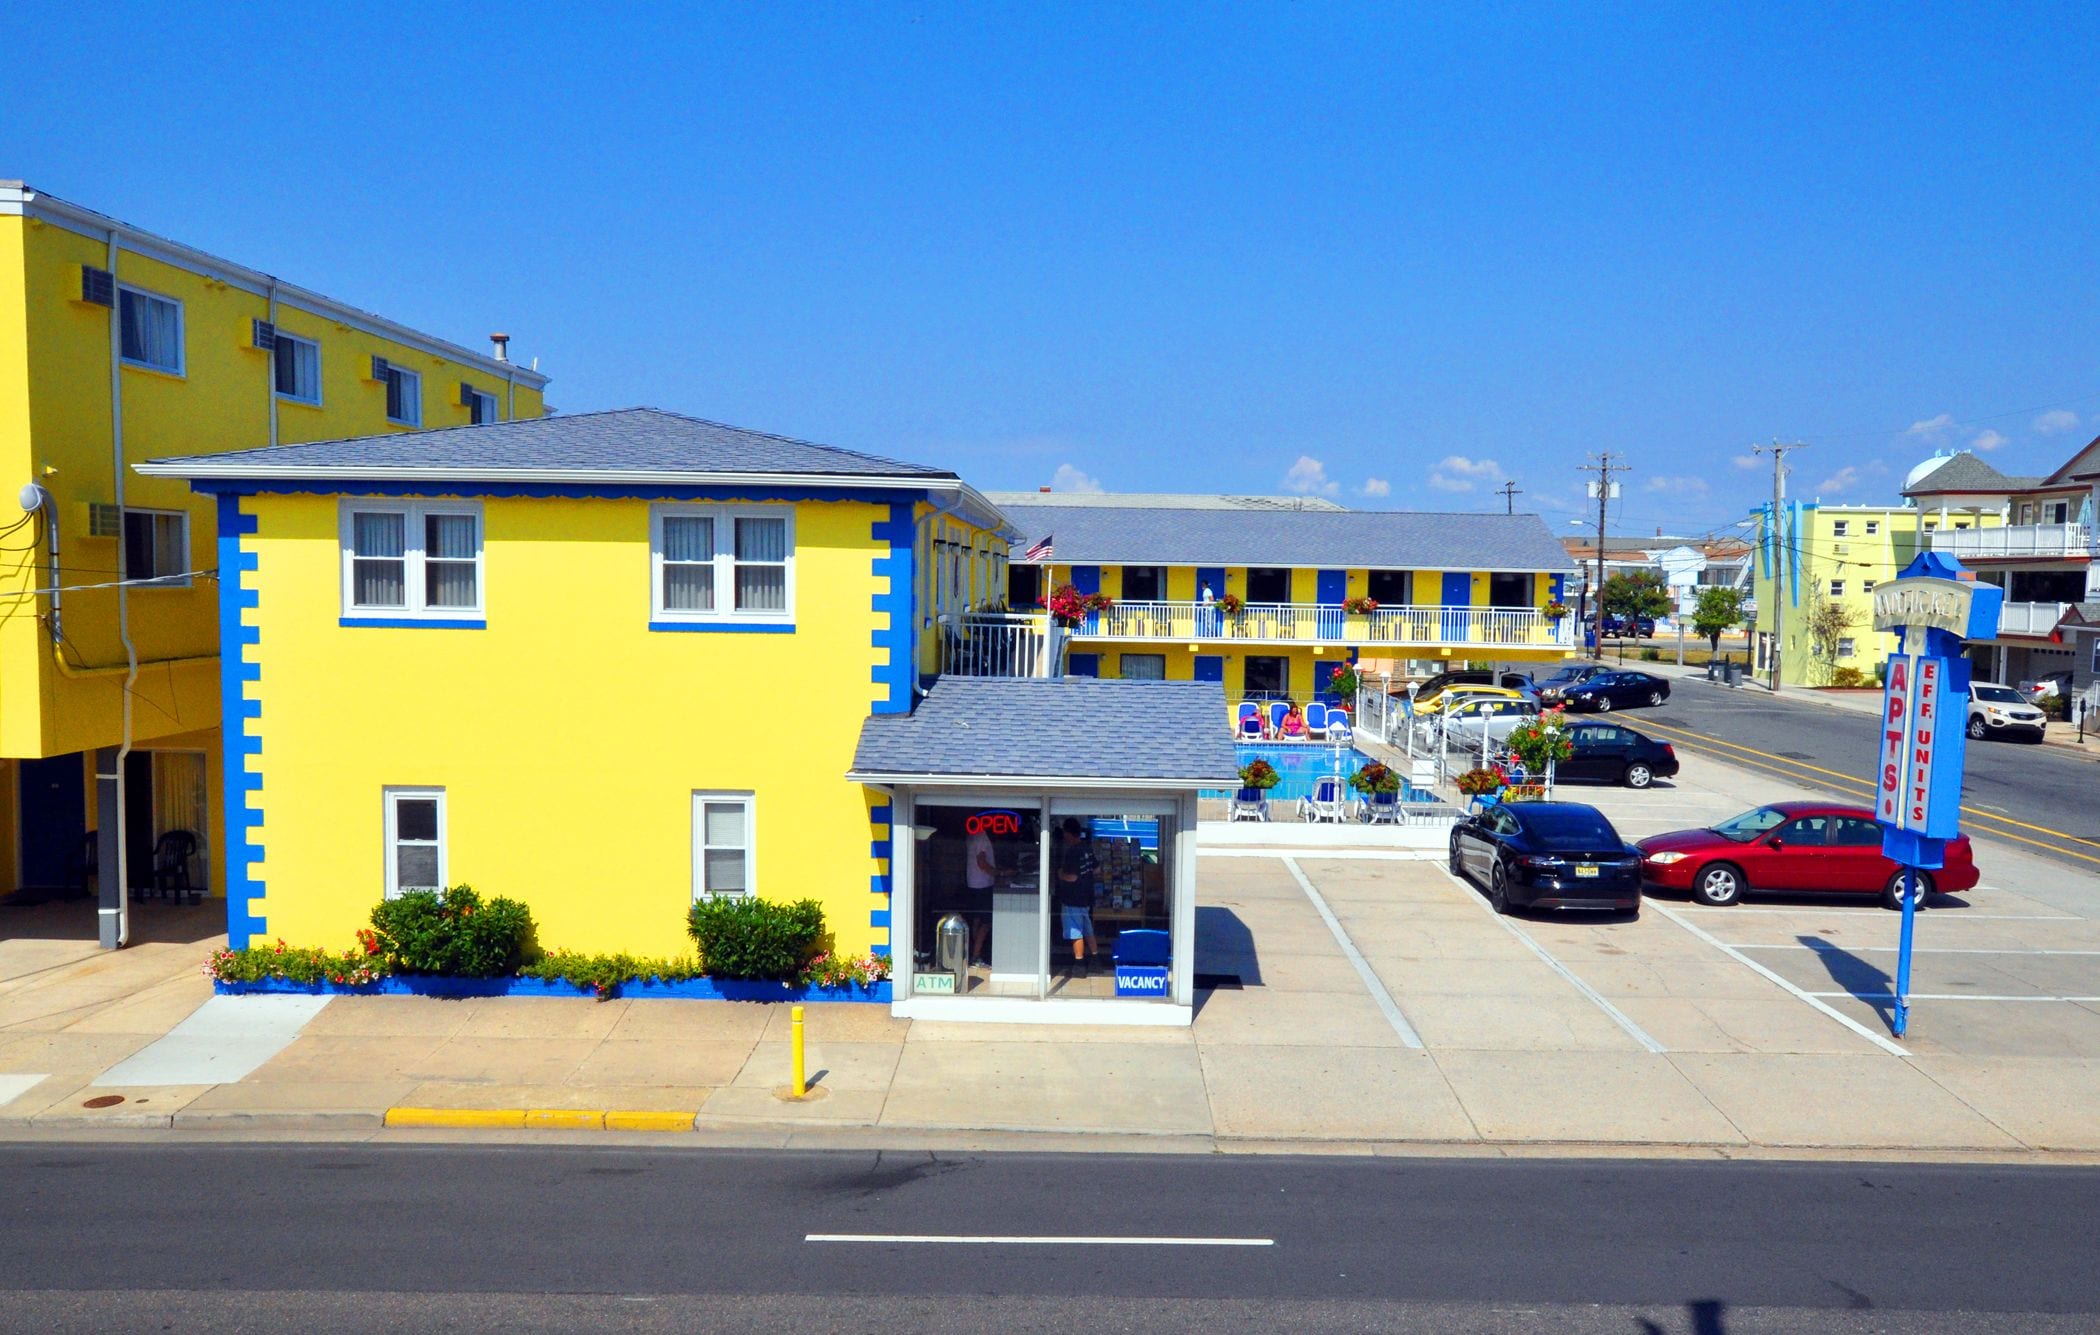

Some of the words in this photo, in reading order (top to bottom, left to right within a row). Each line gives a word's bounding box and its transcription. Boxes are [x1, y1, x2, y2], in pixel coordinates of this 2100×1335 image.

[1913, 730, 1931, 821] UNITS
[965, 815, 1019, 835] OPEN
[916, 976, 952, 989] ATM
[1118, 976, 1165, 989] VACANCY
